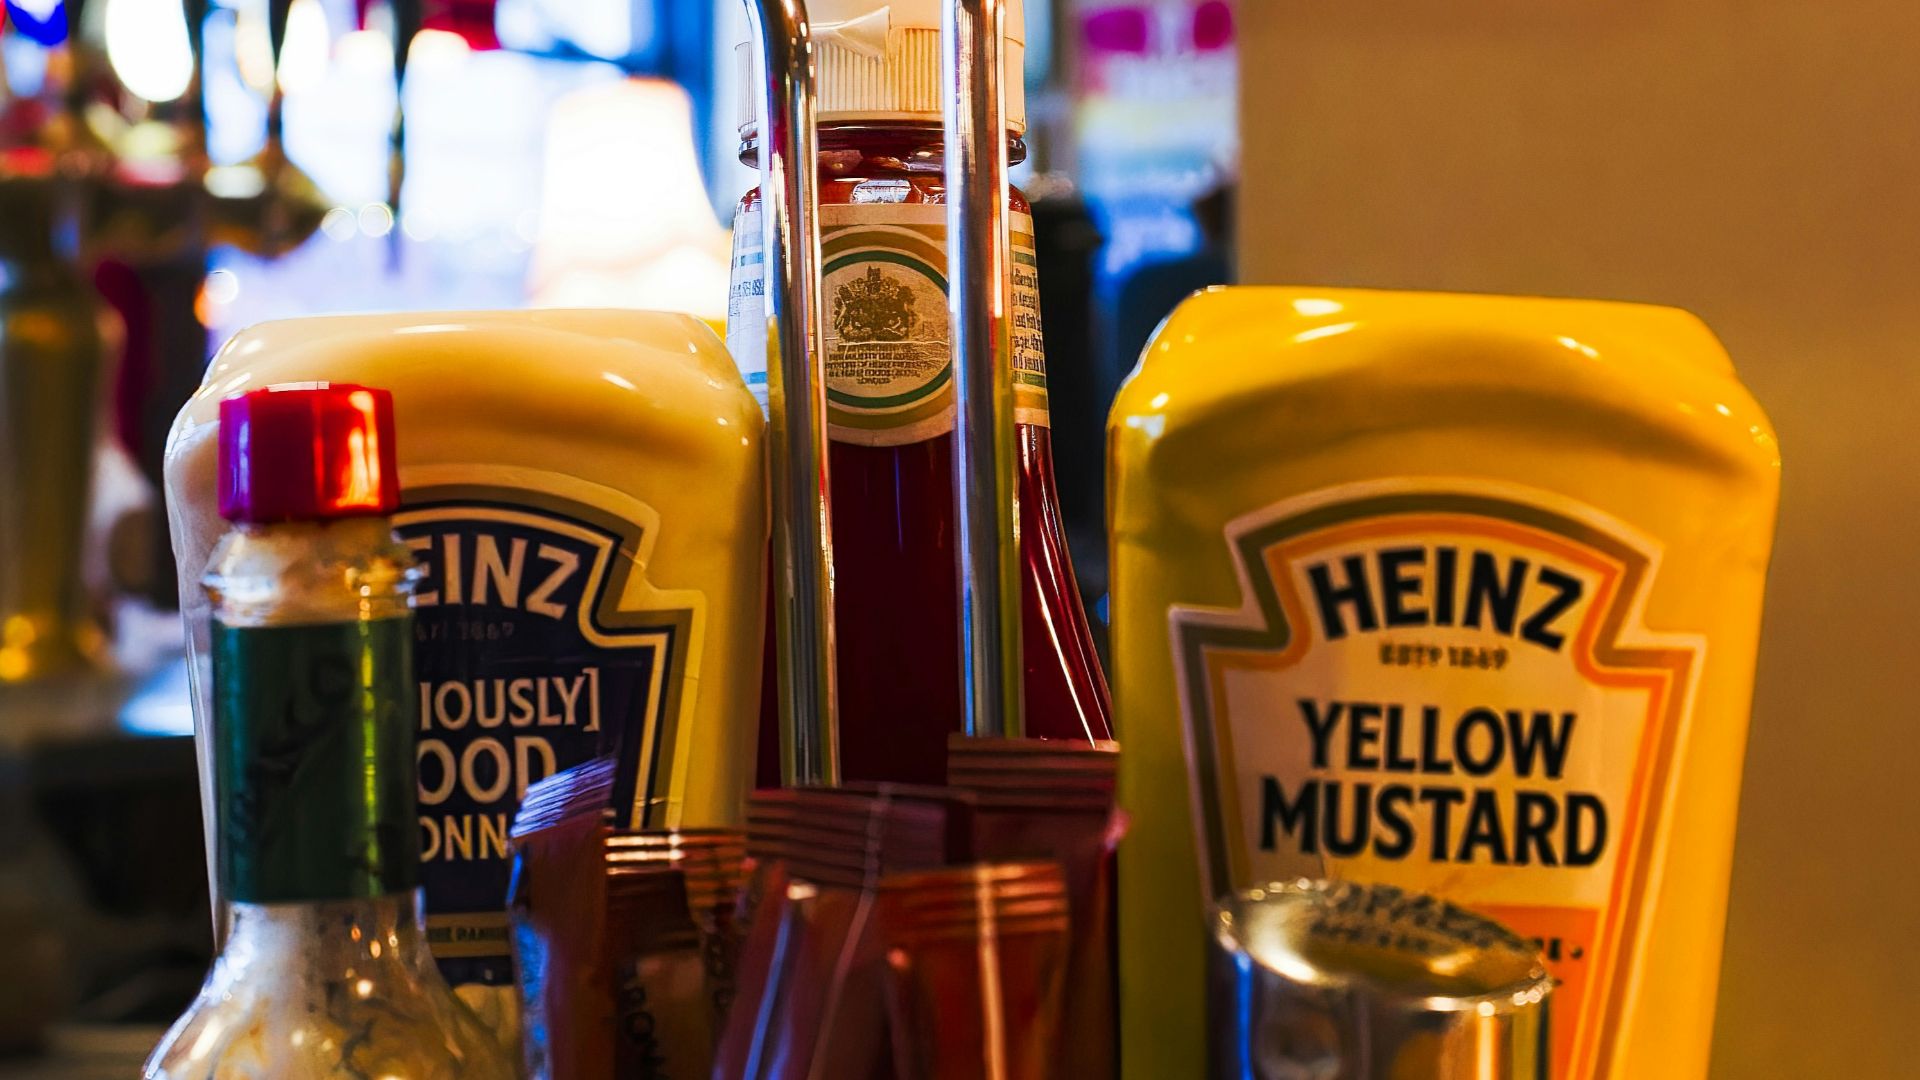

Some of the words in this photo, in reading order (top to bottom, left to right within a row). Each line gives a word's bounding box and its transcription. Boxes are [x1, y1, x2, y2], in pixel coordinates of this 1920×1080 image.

[405, 533, 579, 620] EINZ
[1307, 546, 1585, 653] HEINZ
[419, 667, 601, 732] IOUSLY]
[1297, 698, 1577, 781] YELLOW
[418, 736, 558, 806] OOD
[419, 813, 508, 862] ONN
[1260, 775, 1608, 869] MUSTARD
